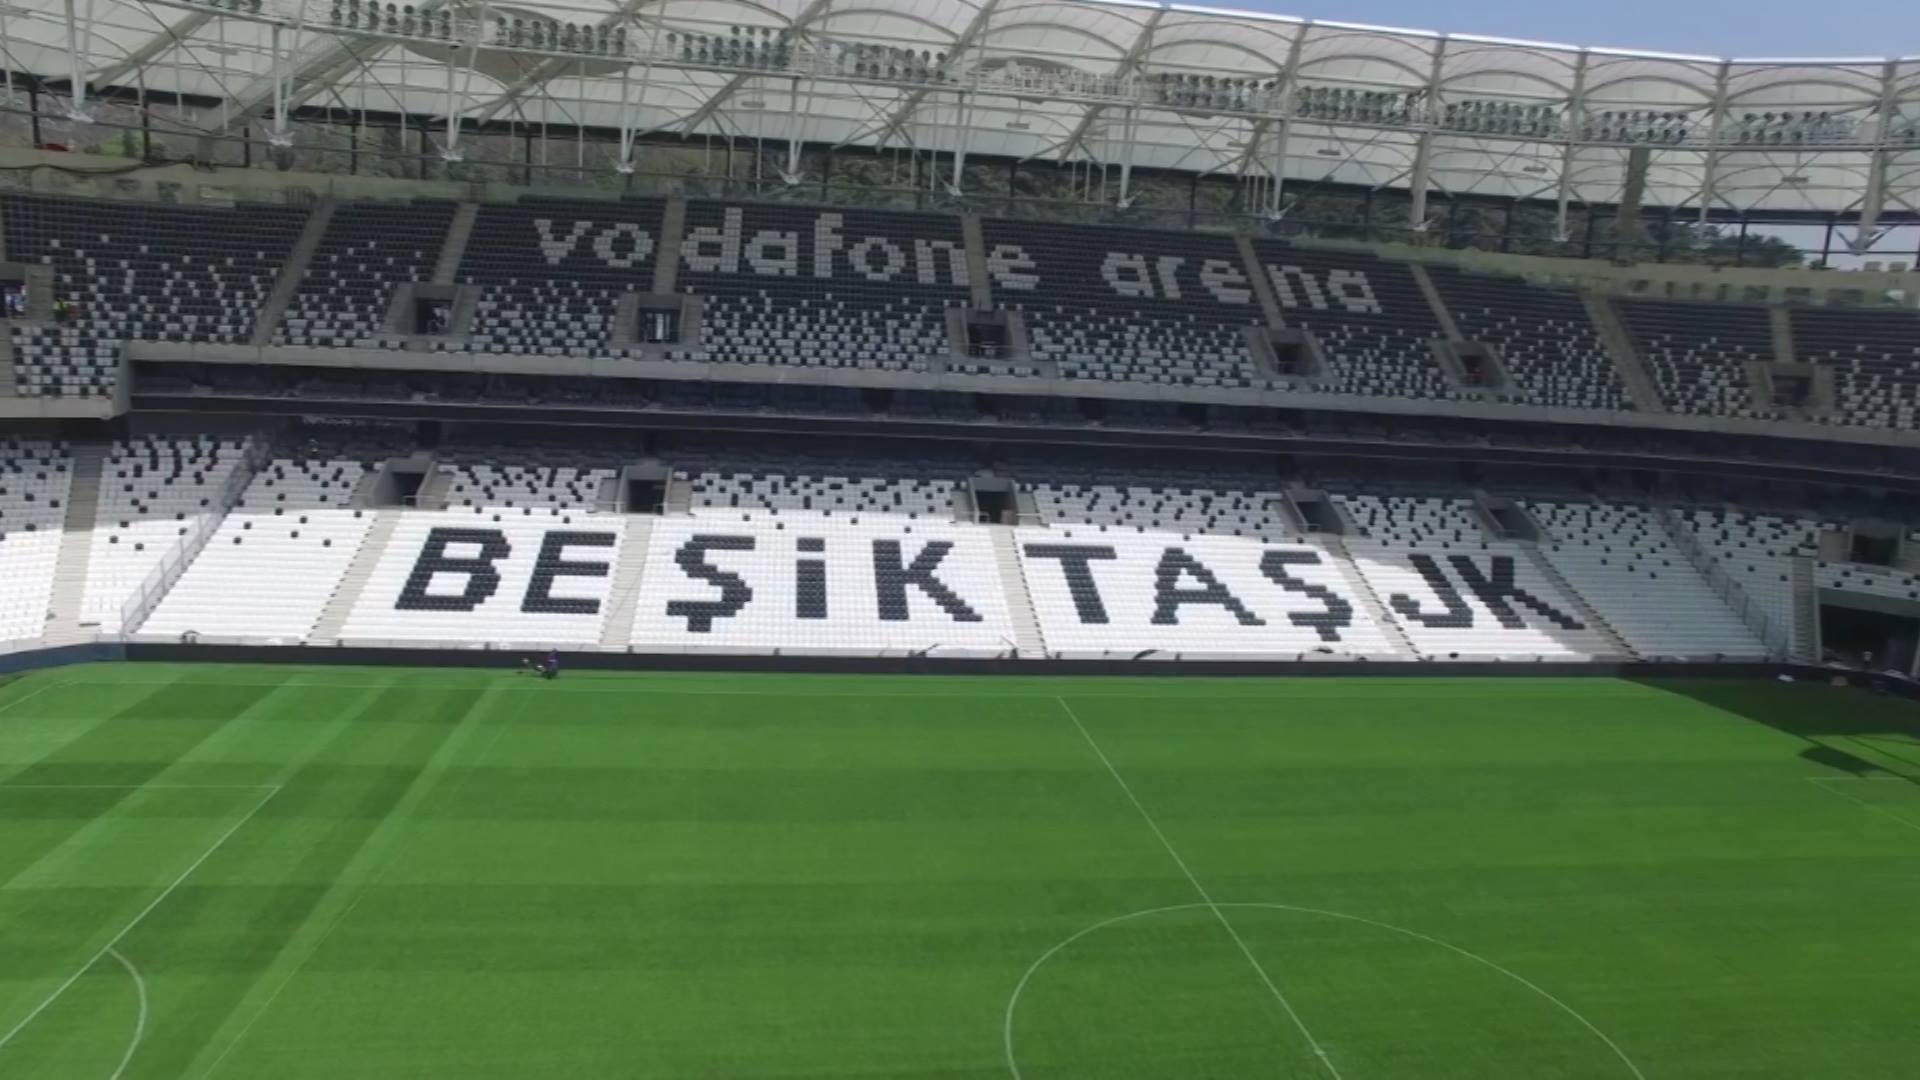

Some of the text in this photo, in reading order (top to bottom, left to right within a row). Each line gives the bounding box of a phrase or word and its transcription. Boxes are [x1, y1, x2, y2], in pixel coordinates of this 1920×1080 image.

[534, 207, 1383, 314] vodafone arena
[1390, 553, 1585, 630] JK
